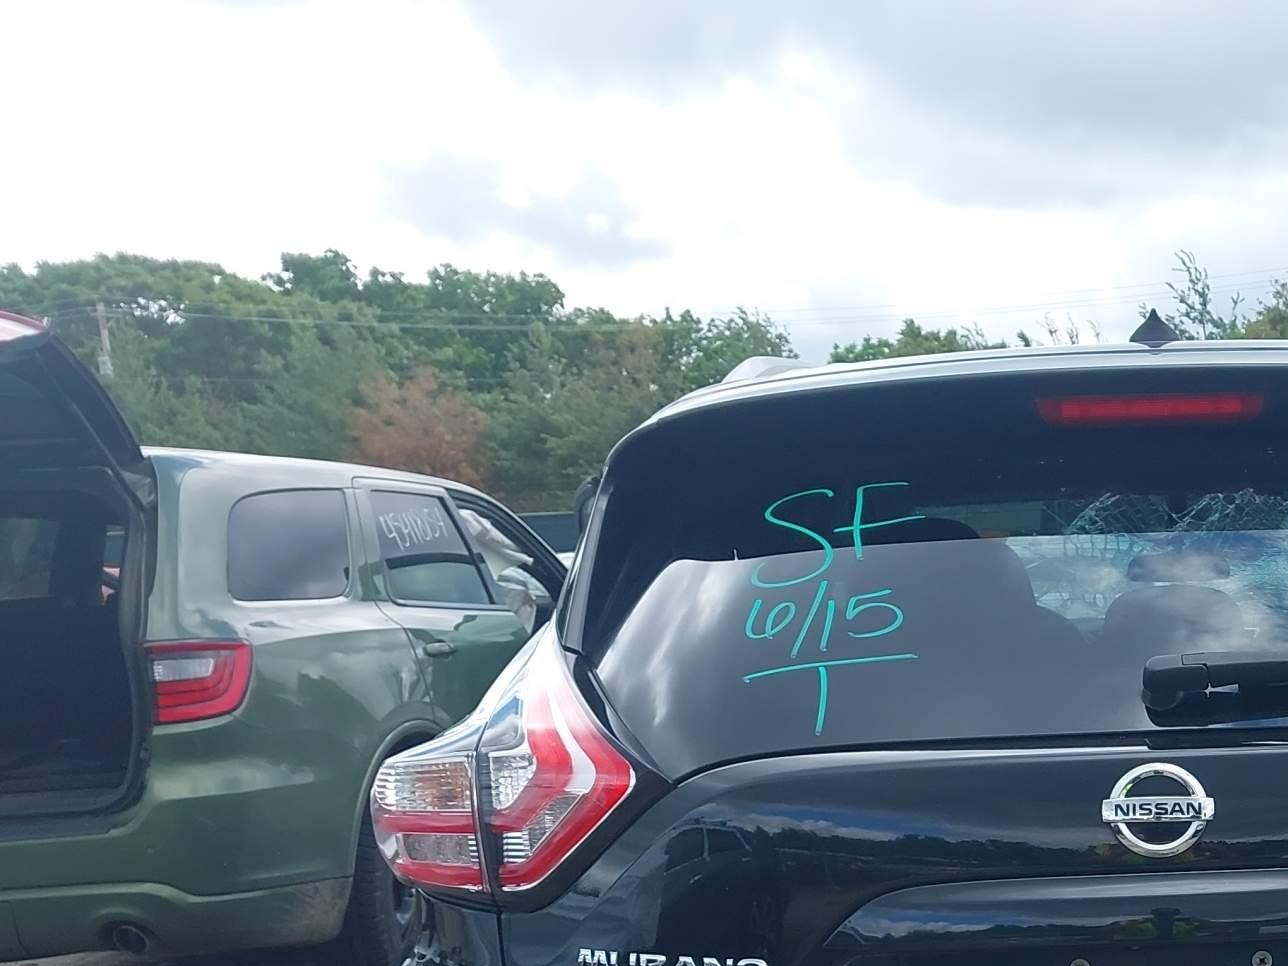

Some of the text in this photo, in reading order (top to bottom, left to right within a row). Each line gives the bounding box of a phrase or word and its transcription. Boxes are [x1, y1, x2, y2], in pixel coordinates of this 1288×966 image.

[751, 482, 927, 588] SF
[745, 580, 904, 659] 6/15
[1114, 802, 1203, 818] NISSAN
